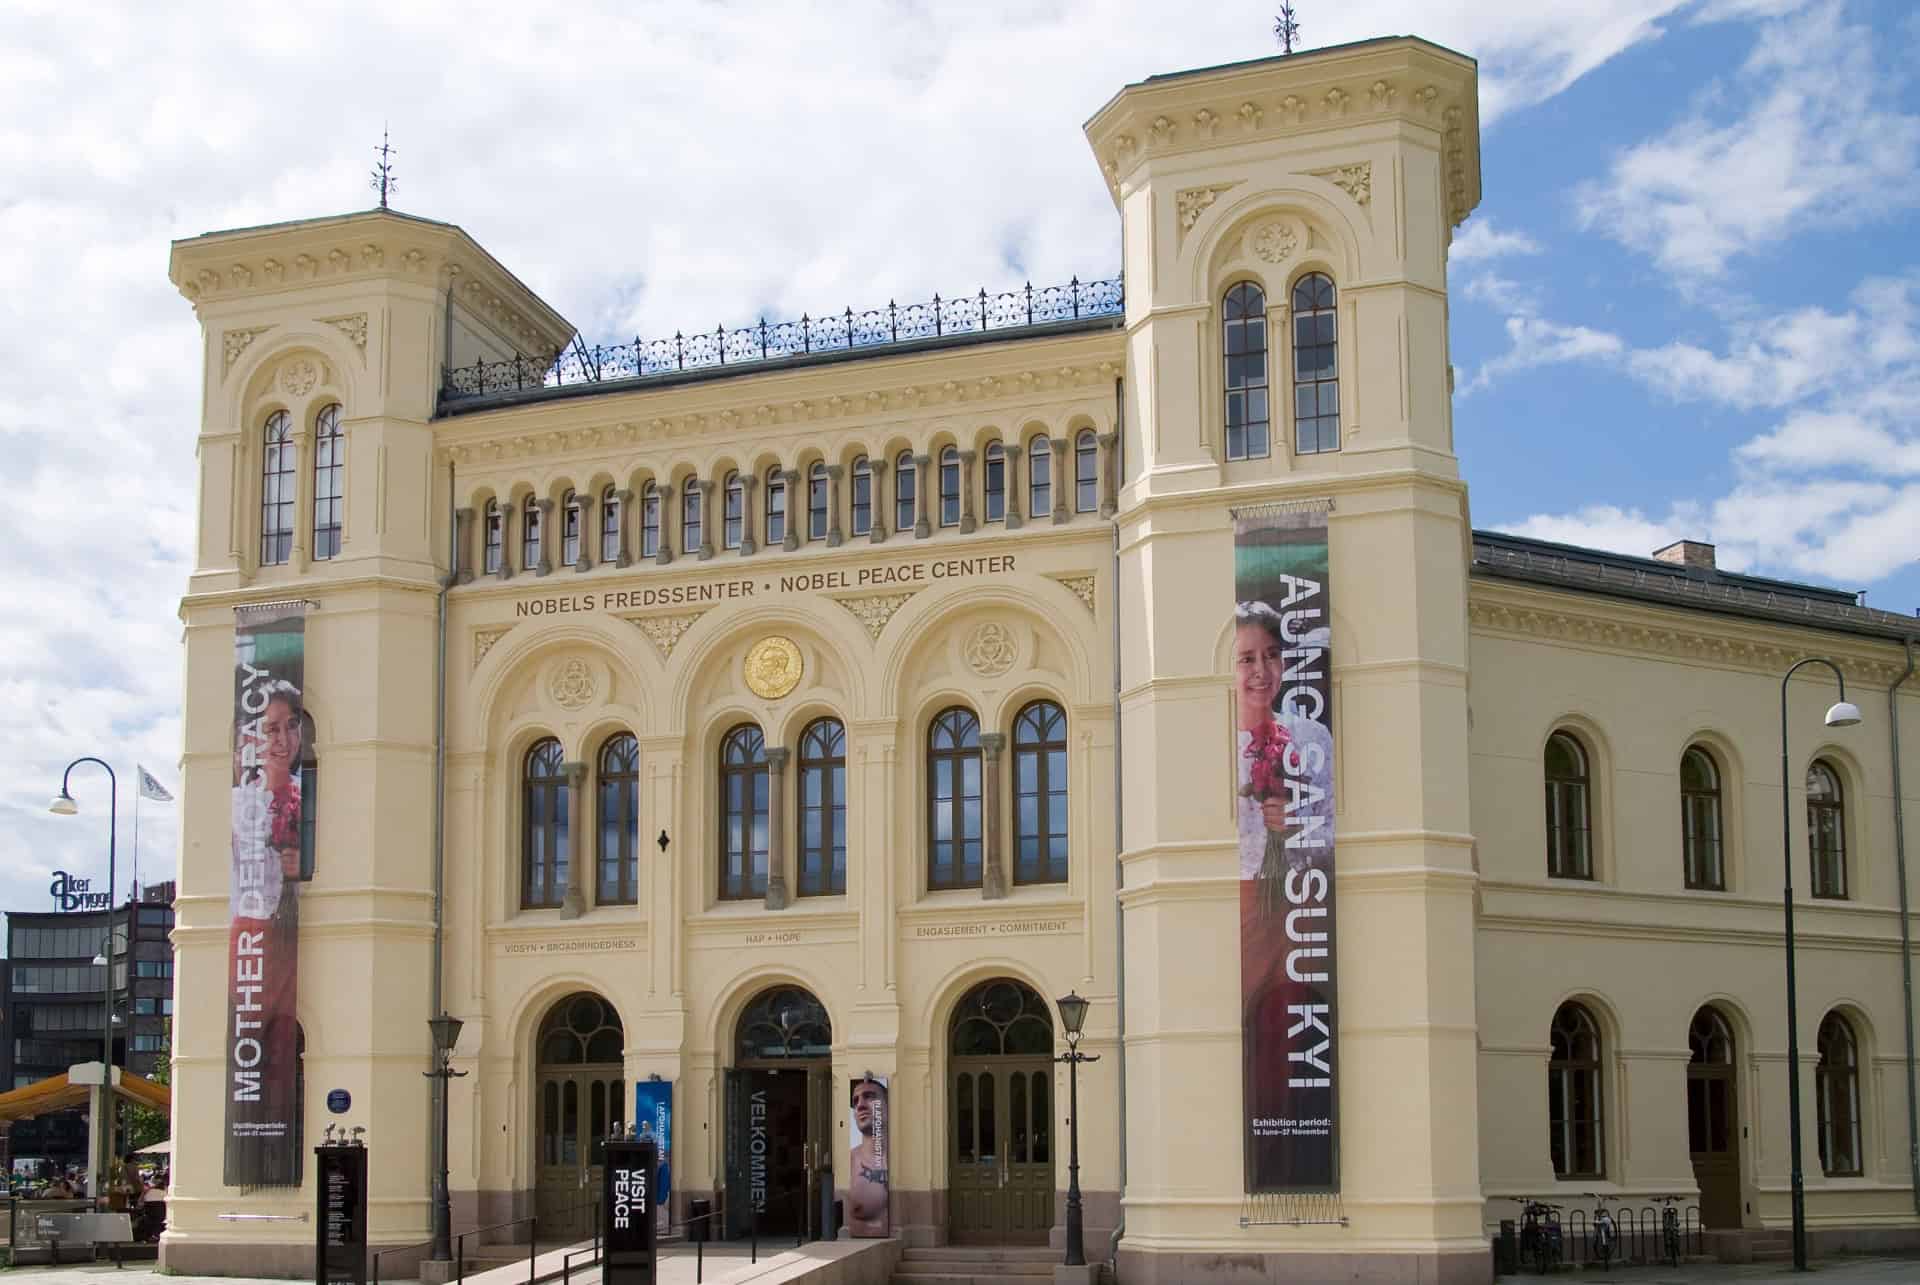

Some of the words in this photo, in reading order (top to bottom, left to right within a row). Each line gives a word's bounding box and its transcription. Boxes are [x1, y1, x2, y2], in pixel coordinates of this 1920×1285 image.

[516, 595, 595, 616] NOBELS
[604, 580, 754, 609] FREDSSENTER
[780, 569, 851, 593] NOBEL
[859, 563, 925, 585] PEACE
[932, 554, 1017, 579] CENTER
[1279, 573, 1325, 725] AUNG
[238, 662, 271, 920] DEMOCRACY
[1283, 743, 1327, 850] SAN
[999, 920, 1067, 933] COMMITMENT
[1284, 866, 1329, 982] SUU
[234, 929, 265, 1102] MOTHER
[1287, 1003, 1331, 1088] KYI
[1252, 1117, 1297, 1127] Exhibition
[1299, 1117, 1332, 1128] period:
[615, 1169, 630, 1229] PEACE
[631, 1168, 646, 1214] VISIT
